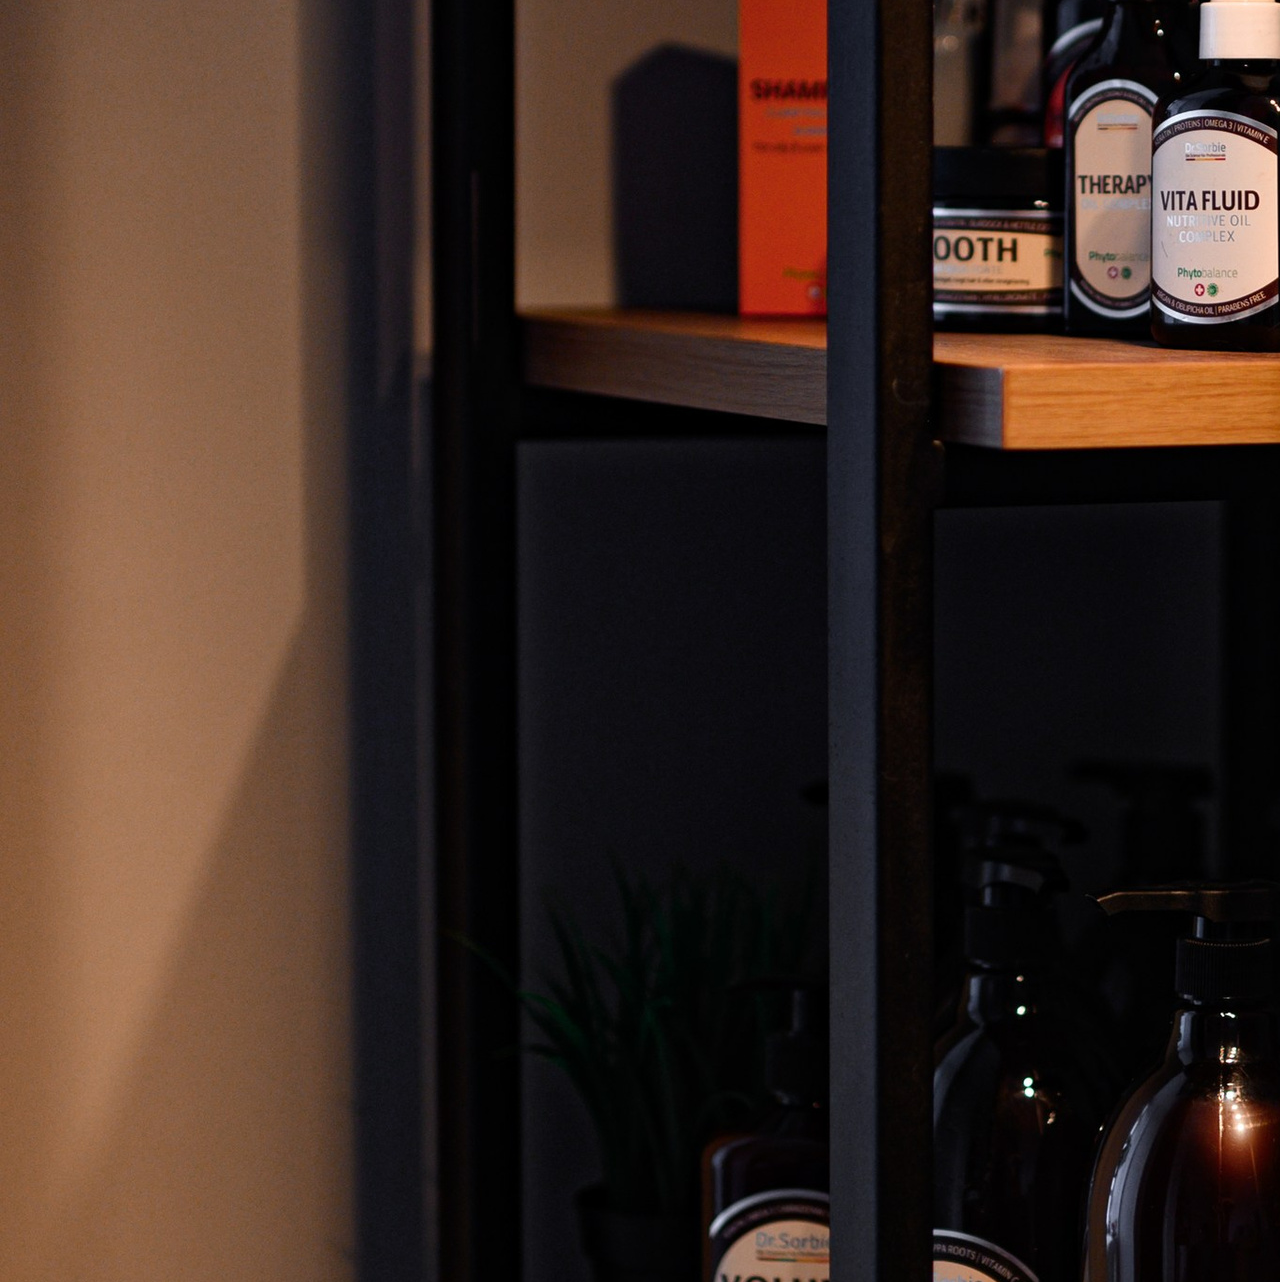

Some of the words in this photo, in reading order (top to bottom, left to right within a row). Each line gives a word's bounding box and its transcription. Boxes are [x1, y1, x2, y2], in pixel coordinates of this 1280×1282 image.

[1174, 119, 1202, 133] PROTEINS
[1204, 118, 1228, 129] OMEGA
[1237, 124, 1264, 141] VITAMIN
[1161, 190, 1198, 211] VITA
[1202, 190, 1260, 211] FLUID
[1230, 214, 1251, 226] OIL
[1177, 267, 1238, 280] Phytobalance
[1218, 299, 1249, 313] PARABENS
[1249, 291, 1267, 304] FREE
